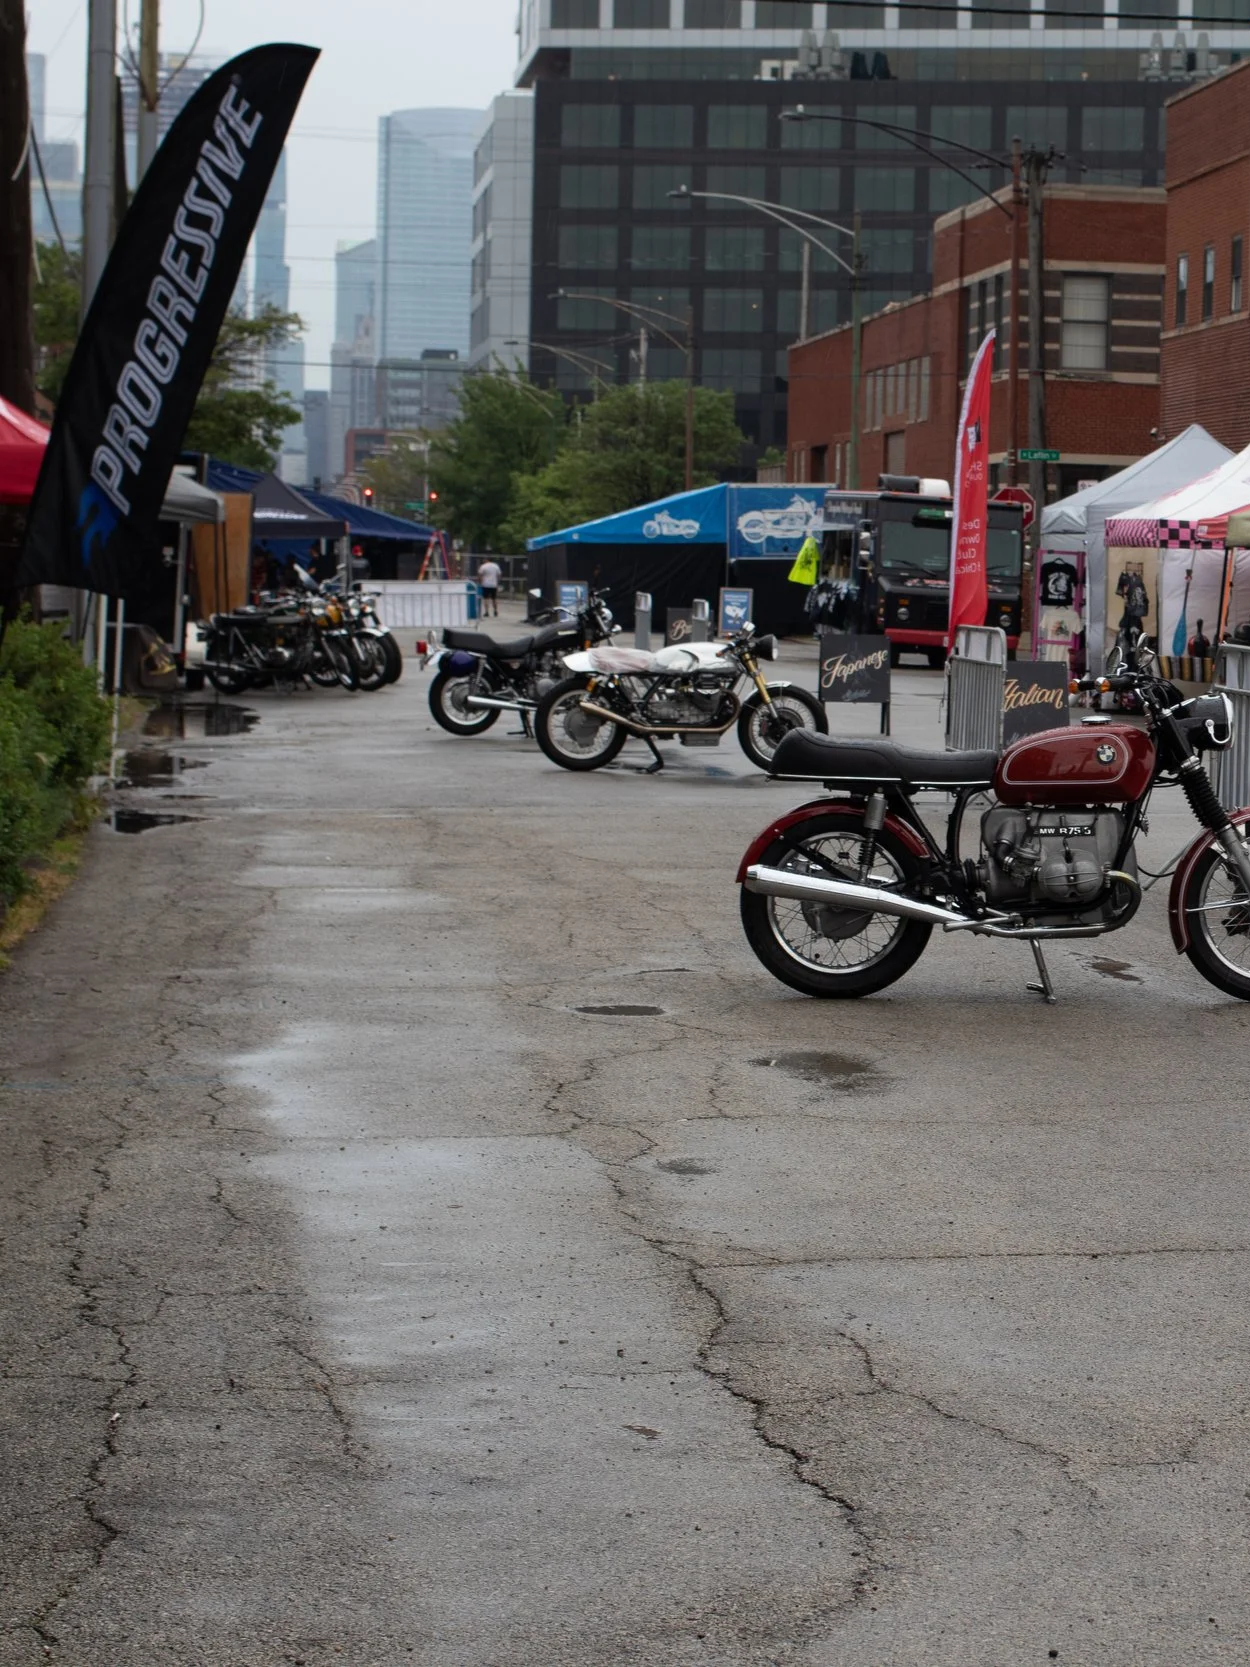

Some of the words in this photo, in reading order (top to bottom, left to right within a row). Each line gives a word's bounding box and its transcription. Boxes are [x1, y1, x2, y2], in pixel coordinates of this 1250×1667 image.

[91, 84, 263, 516] PROGRESSIVE
[821, 649, 888, 688] Japanese
[1004, 679, 1064, 712] Italian
